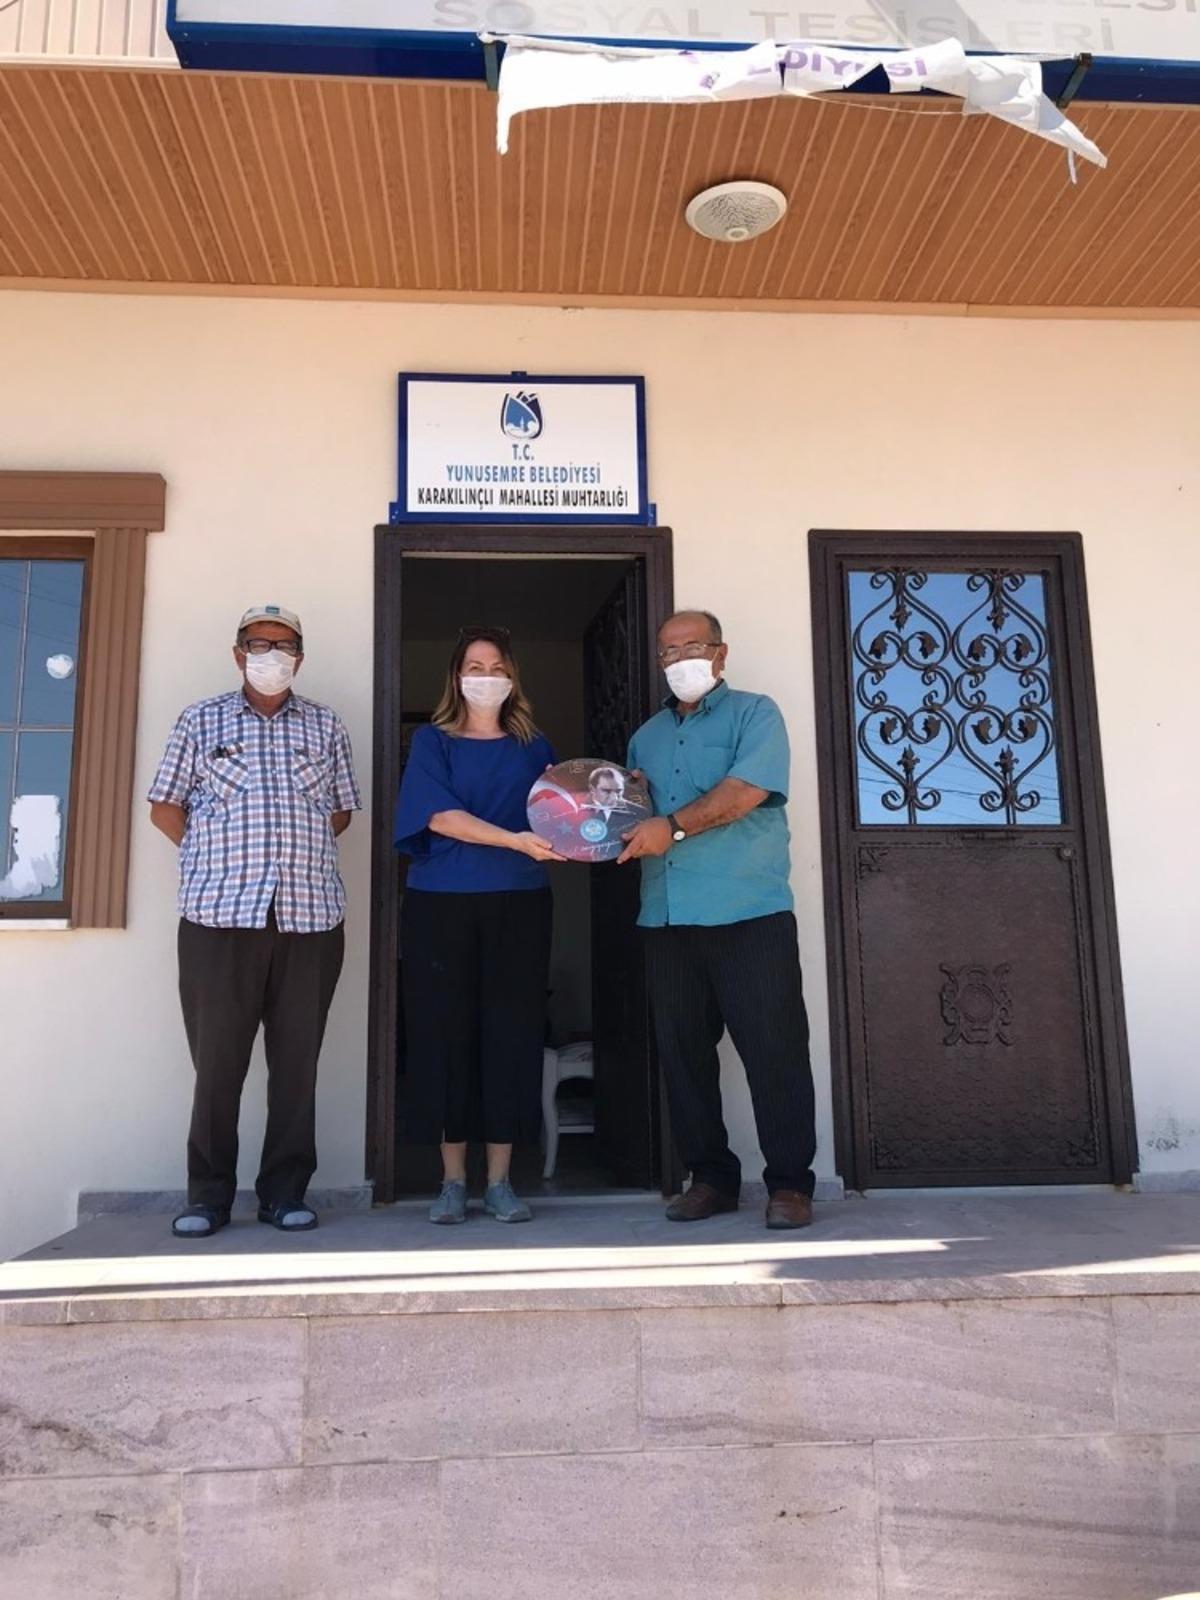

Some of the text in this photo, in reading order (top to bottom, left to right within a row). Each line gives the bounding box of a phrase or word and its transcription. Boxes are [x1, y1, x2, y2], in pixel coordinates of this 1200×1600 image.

[432, 0, 722, 38] SOSYAL
[512, 444, 535, 461] T.C.
[446, 463, 602, 484] YUNUSEMRE BELEDİYESİ
[417, 485, 629, 510] KARAKILINÇLI MAHALLESİ MUHTARLIĞI
